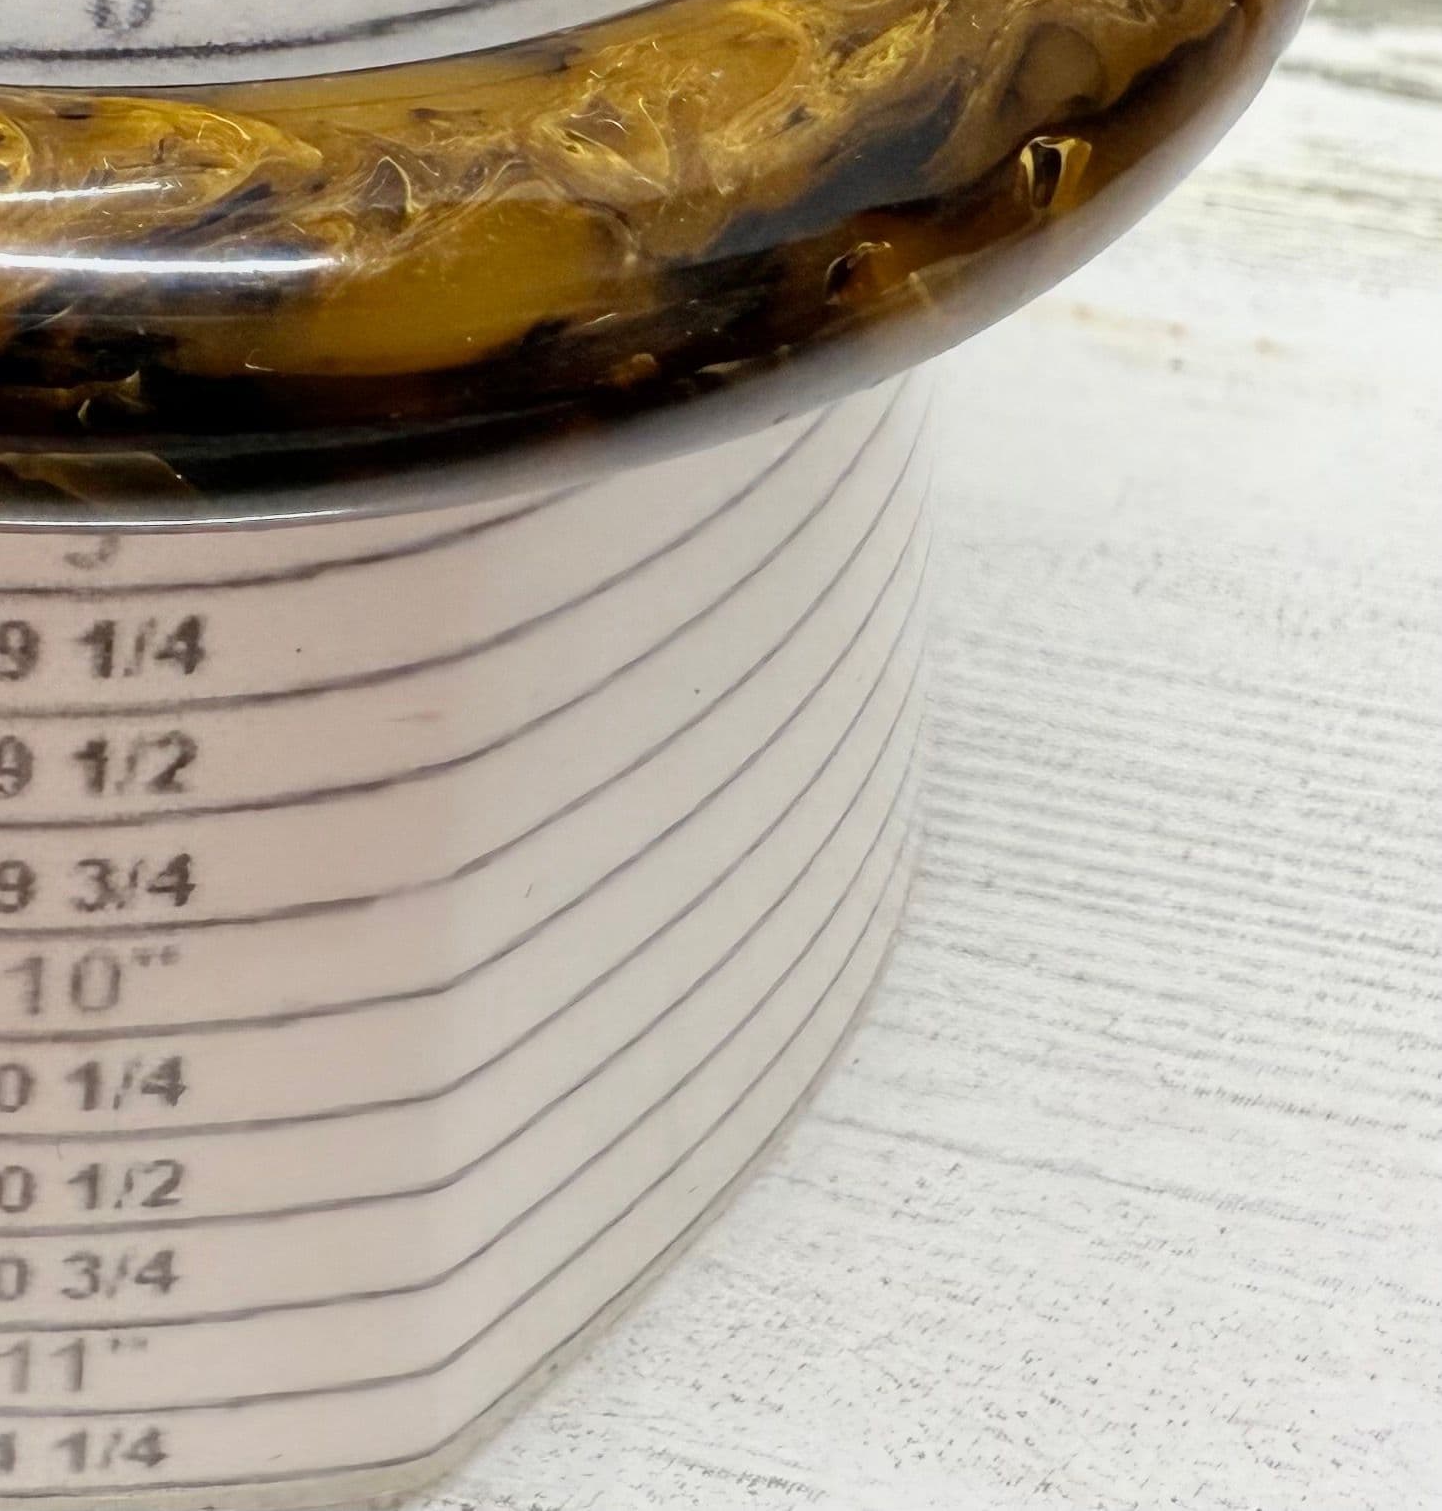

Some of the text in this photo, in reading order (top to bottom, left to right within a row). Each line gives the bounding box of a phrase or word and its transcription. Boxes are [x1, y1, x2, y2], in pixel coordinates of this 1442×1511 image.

[77, 614, 206, 679] 1/4
[73, 729, 198, 794] 1/2
[71, 853, 196, 913] 3/4
[65, 1055, 188, 1110] 1/4
[67, 1159, 185, 1210] 1/2
[61, 1249, 181, 1300] 3/4
[55, 1428, 169, 1472] 1/4
